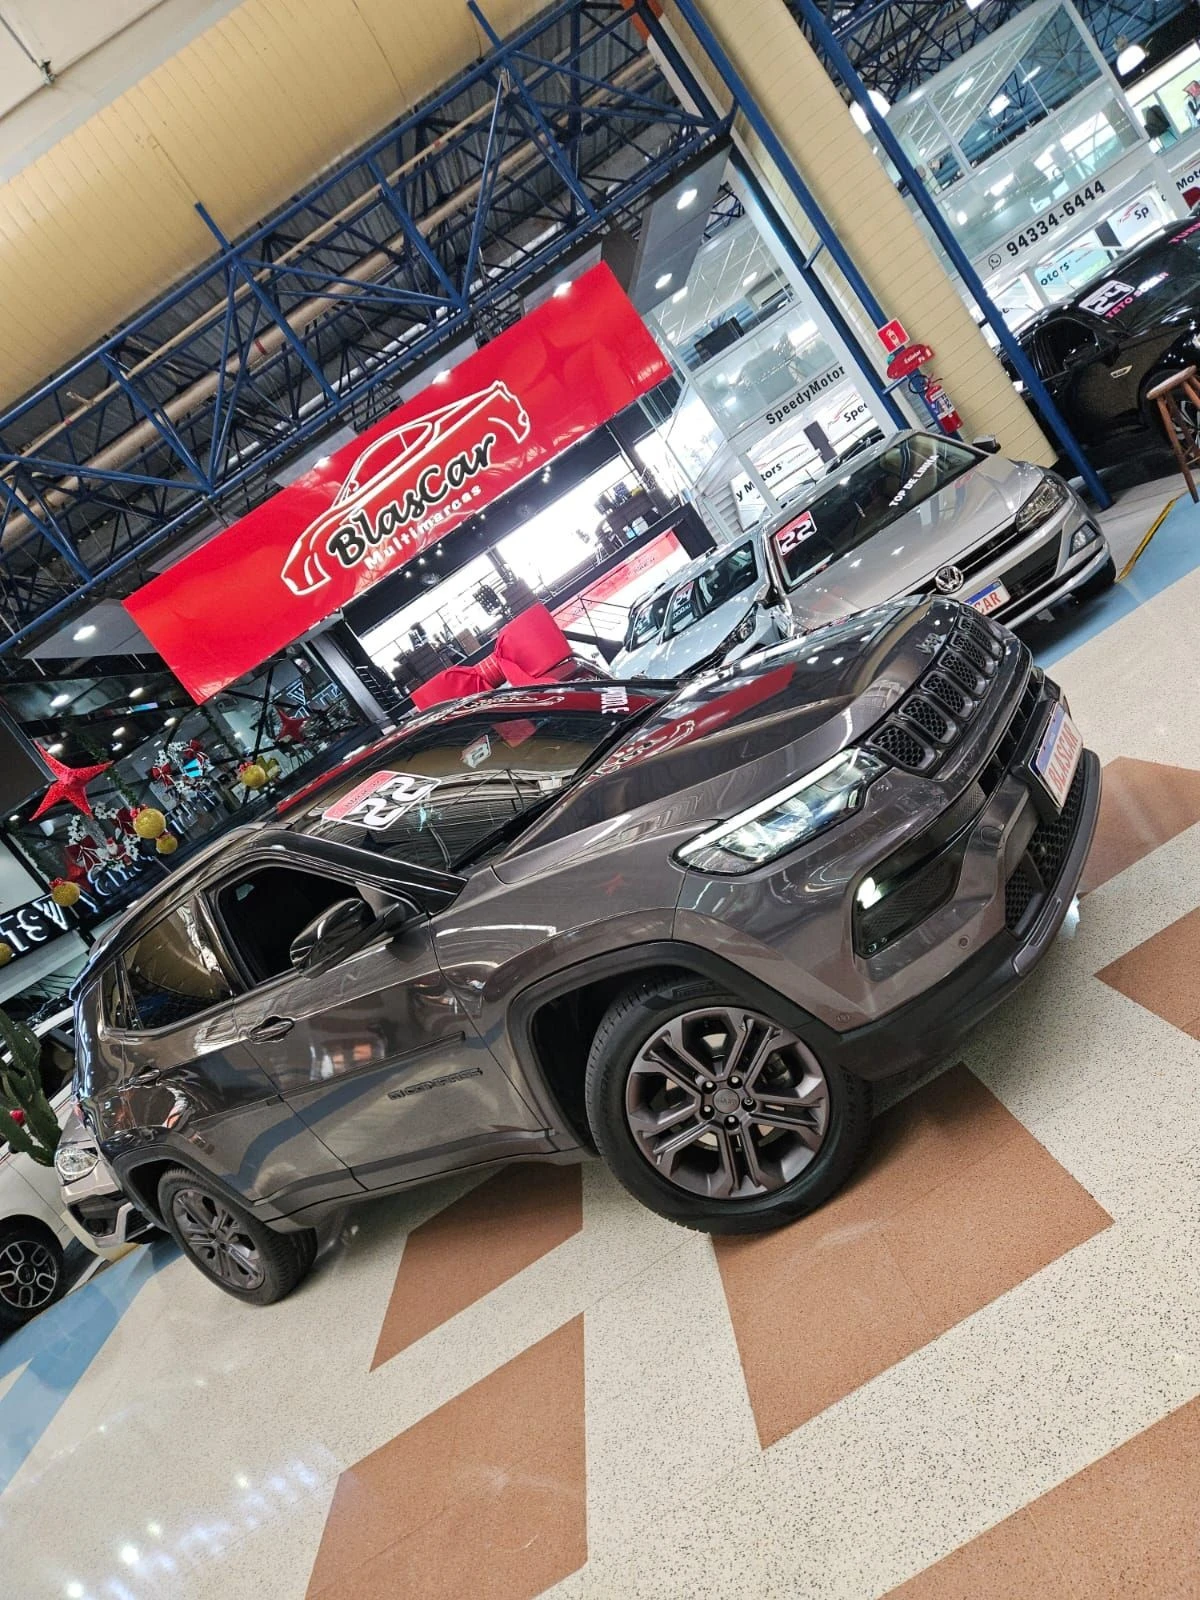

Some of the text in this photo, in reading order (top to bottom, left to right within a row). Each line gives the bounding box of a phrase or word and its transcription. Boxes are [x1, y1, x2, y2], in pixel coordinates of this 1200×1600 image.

[1006, 180, 1105, 256] 94334-6444
[1105, 297, 1133, 318] TETO
[765, 365, 845, 425] SpeedyMotor
[327, 434, 496, 568] BlasCar
[888, 489, 906, 507] TOP
[902, 476, 919, 490] DE
[362, 484, 482, 571] Multimarcas
[780, 519, 815, 553] 22
[1048, 726, 1080, 792] BLASCAR
[350, 776, 434, 826] 22
